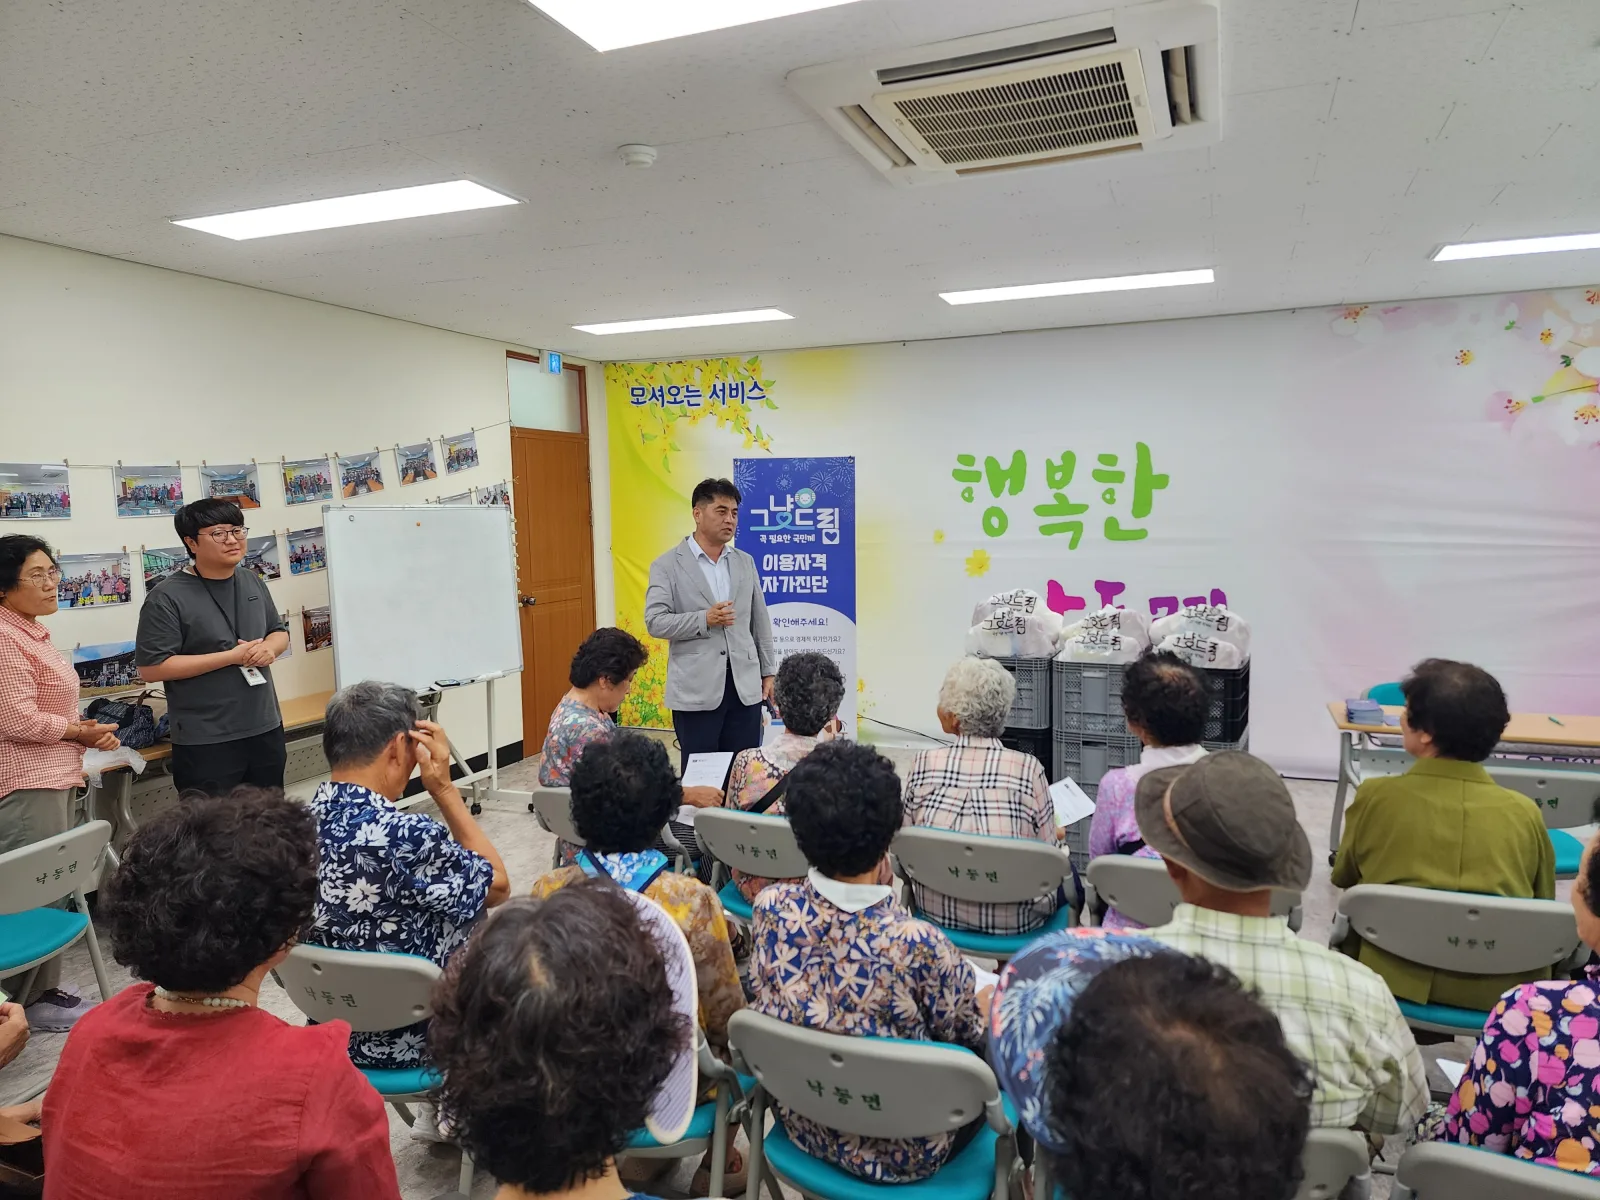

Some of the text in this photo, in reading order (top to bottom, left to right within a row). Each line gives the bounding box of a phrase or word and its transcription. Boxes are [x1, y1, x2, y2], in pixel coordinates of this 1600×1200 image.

[630, 380, 767, 408] 모셔오는 서비스
[952, 441, 1170, 550] 행복한
[749, 487, 840, 545] 그냥드림
[759, 533, 816, 544] 꼭 필요한 국민께
[762, 553, 827, 572] 이용자격
[761, 575, 829, 594] 자가진단
[772, 617, 829, 628] 확인해주세요!
[735, 843, 778, 860] 낙동면
[36, 860, 77, 885] 낙동면
[947, 865, 999, 883] 낙동면
[1446, 936, 1496, 951] 낙동면
[304, 986, 358, 1008] 낙동면
[805, 1078, 882, 1111] 낙동면
